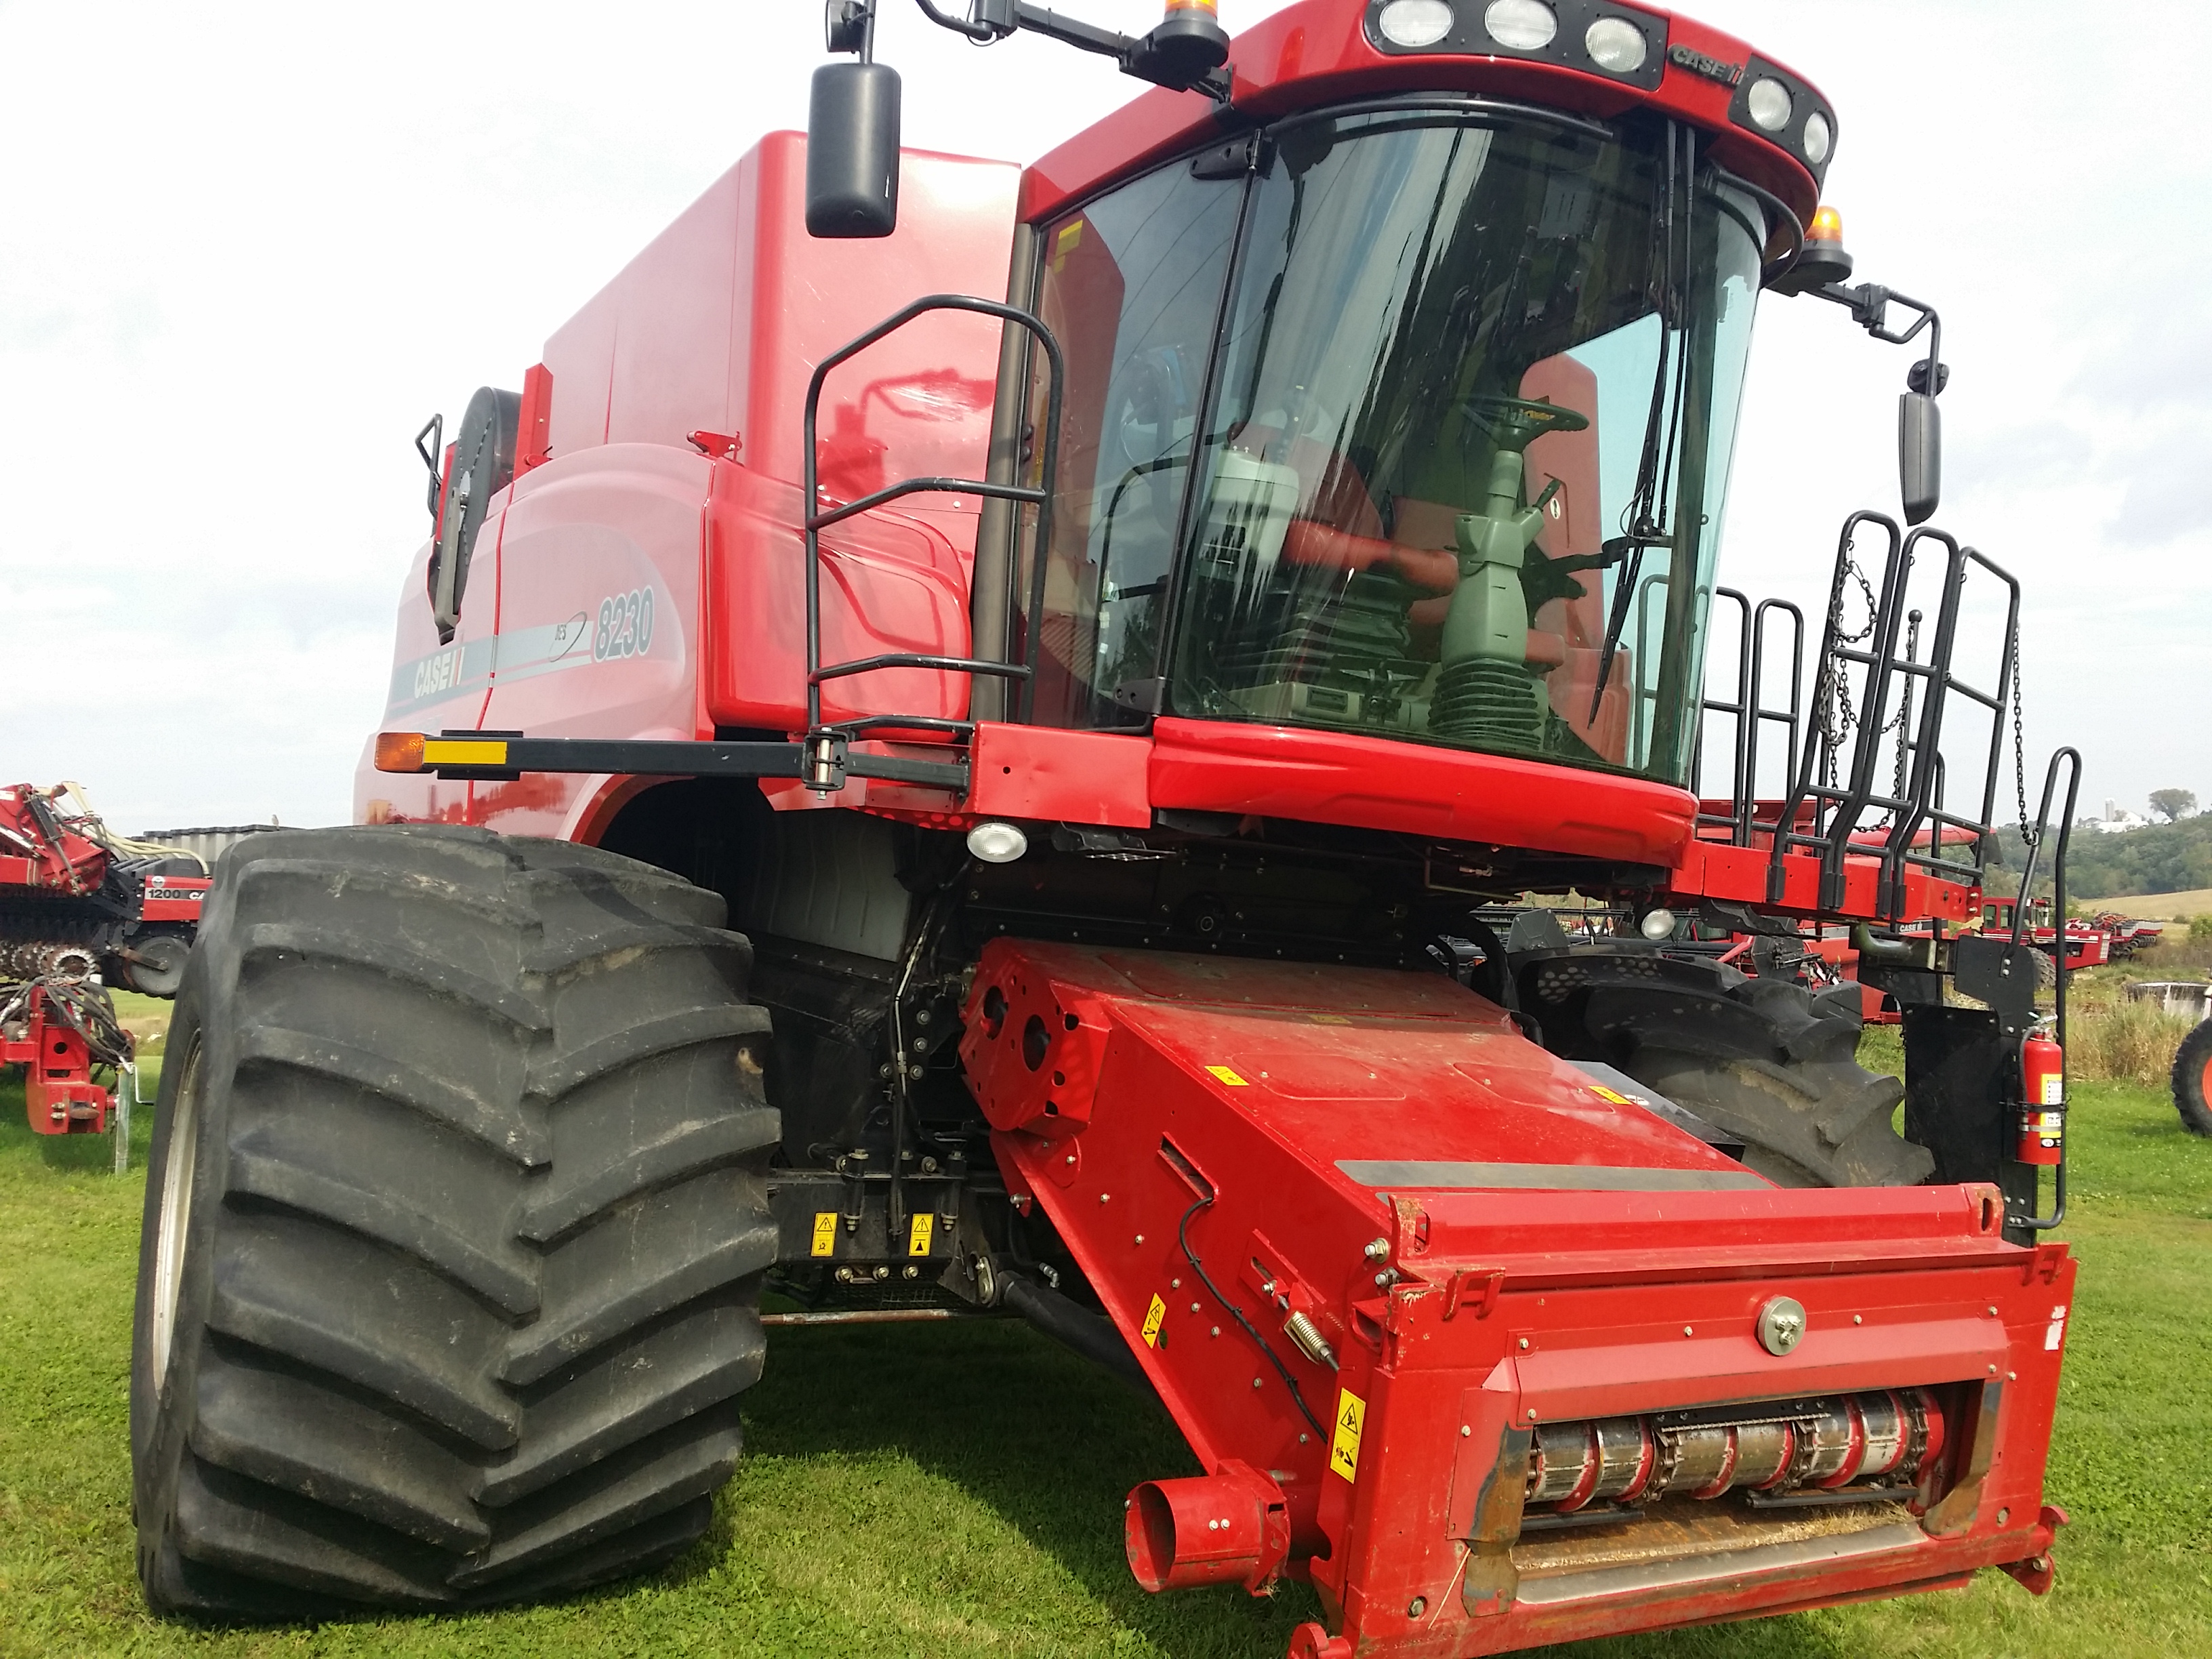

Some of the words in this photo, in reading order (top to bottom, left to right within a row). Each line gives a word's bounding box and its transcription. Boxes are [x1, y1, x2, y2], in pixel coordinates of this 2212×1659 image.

[1673, 47, 1726, 78] CASE
[594, 585, 654, 663] 8230
[414, 652, 451, 699] CASE
[148, 889, 180, 899] 1200
[1899, 924, 1917, 933] CASE
